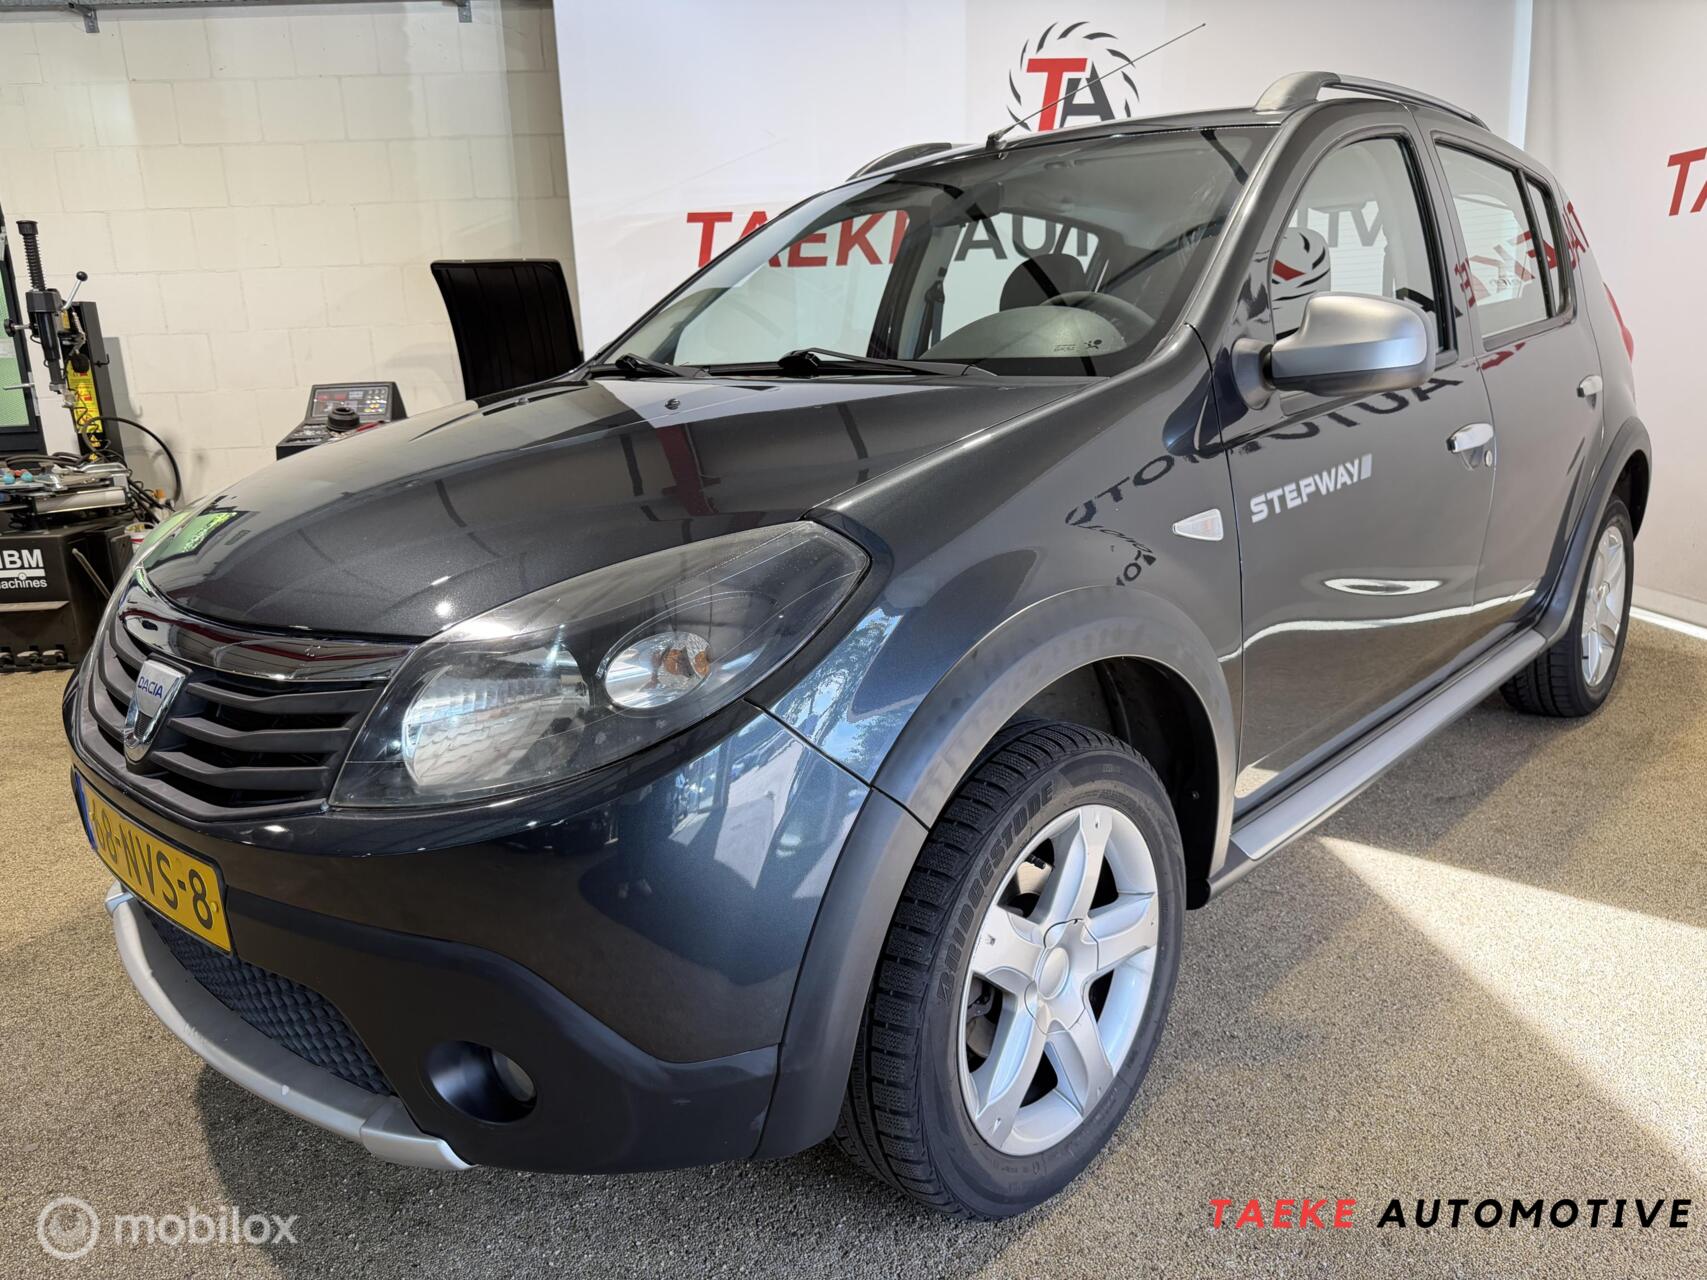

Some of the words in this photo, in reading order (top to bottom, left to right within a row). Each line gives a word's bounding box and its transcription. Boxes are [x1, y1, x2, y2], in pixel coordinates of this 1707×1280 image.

[1026, 57, 1116, 132] TA
[1250, 457, 1361, 523] STEPWAY
[0, 548, 44, 569] BM
[0, 578, 48, 590] achines
[137, 676, 164, 699] DACIA
